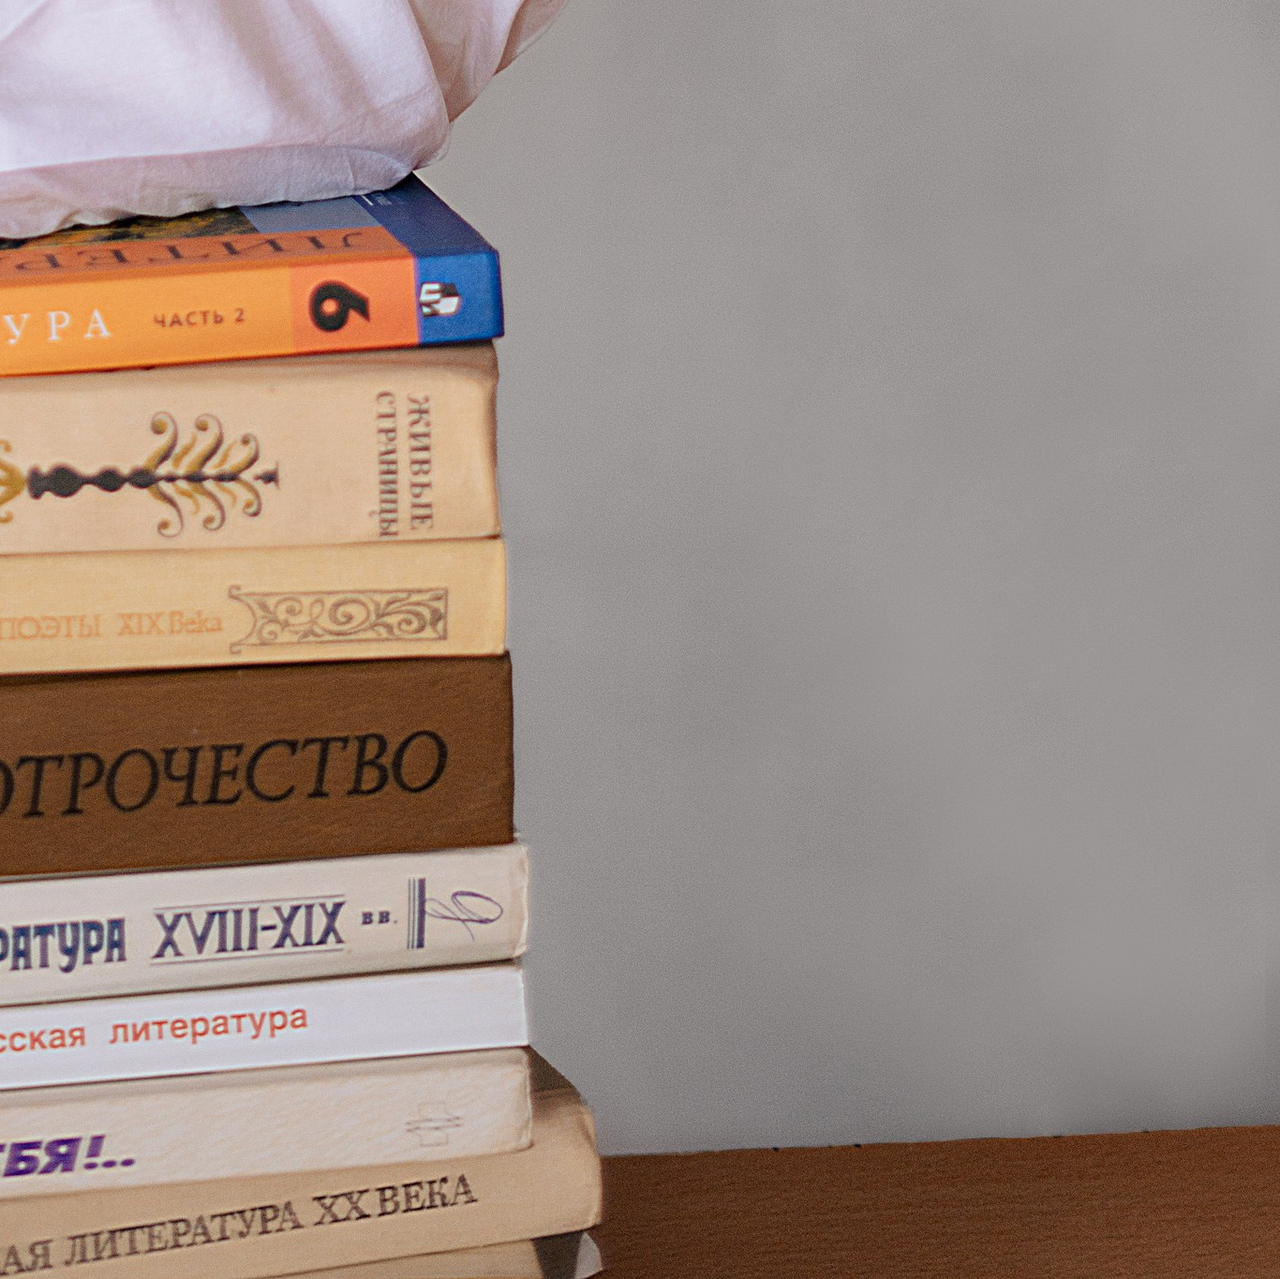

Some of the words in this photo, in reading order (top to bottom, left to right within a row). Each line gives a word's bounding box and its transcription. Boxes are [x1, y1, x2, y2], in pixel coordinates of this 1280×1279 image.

[154, 310, 223, 328] ЧАСТЬ
[233, 307, 246, 323] 2
[308, 280, 371, 333] 6
[369, 391, 399, 538] СТРАНИЦЫ
[407, 393, 433, 529] ЖИВЫЕ
[109, 1006, 309, 1045] литература
[64, 1200, 306, 1270] ЛИТЕРАТУРА
[375, 1173, 479, 1218] ВЕКА
